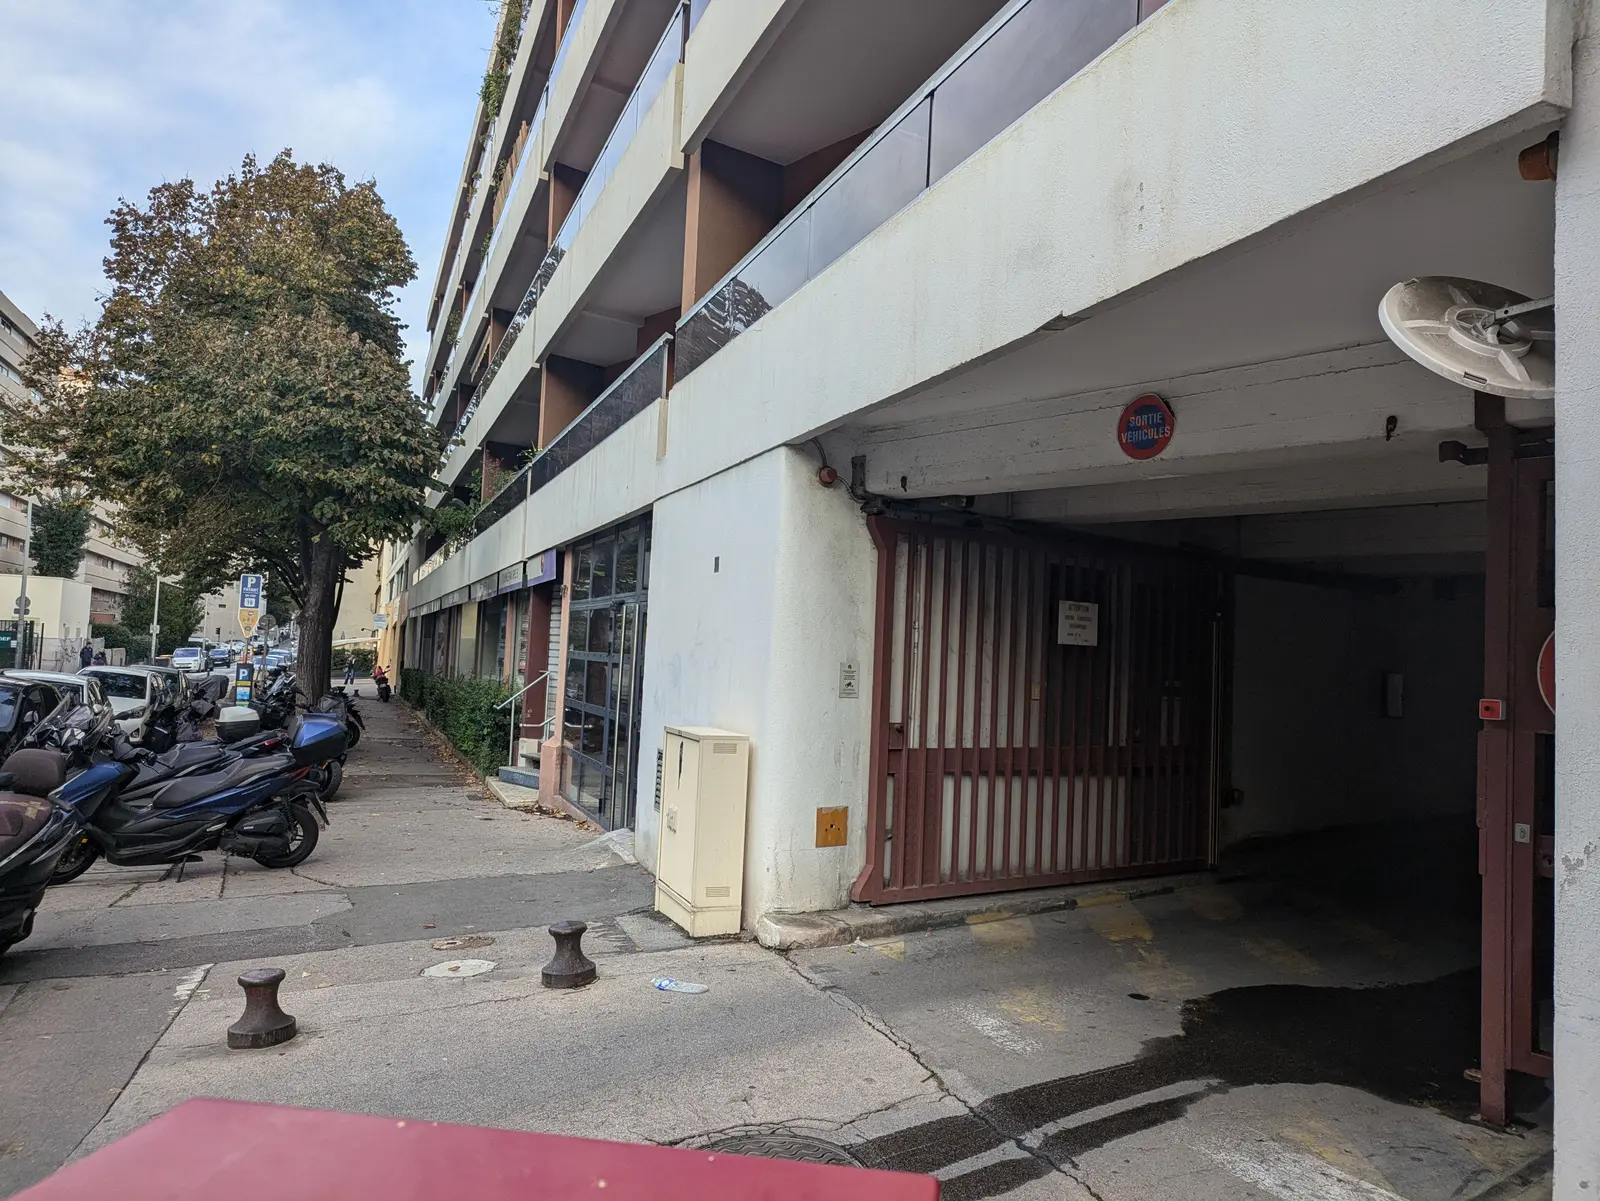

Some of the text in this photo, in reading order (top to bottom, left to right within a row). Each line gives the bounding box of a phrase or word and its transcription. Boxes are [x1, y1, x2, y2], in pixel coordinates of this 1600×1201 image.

[1129, 412, 1163, 427] SORTIE
[247, 576, 256, 588] P
[240, 669, 248, 680] P
